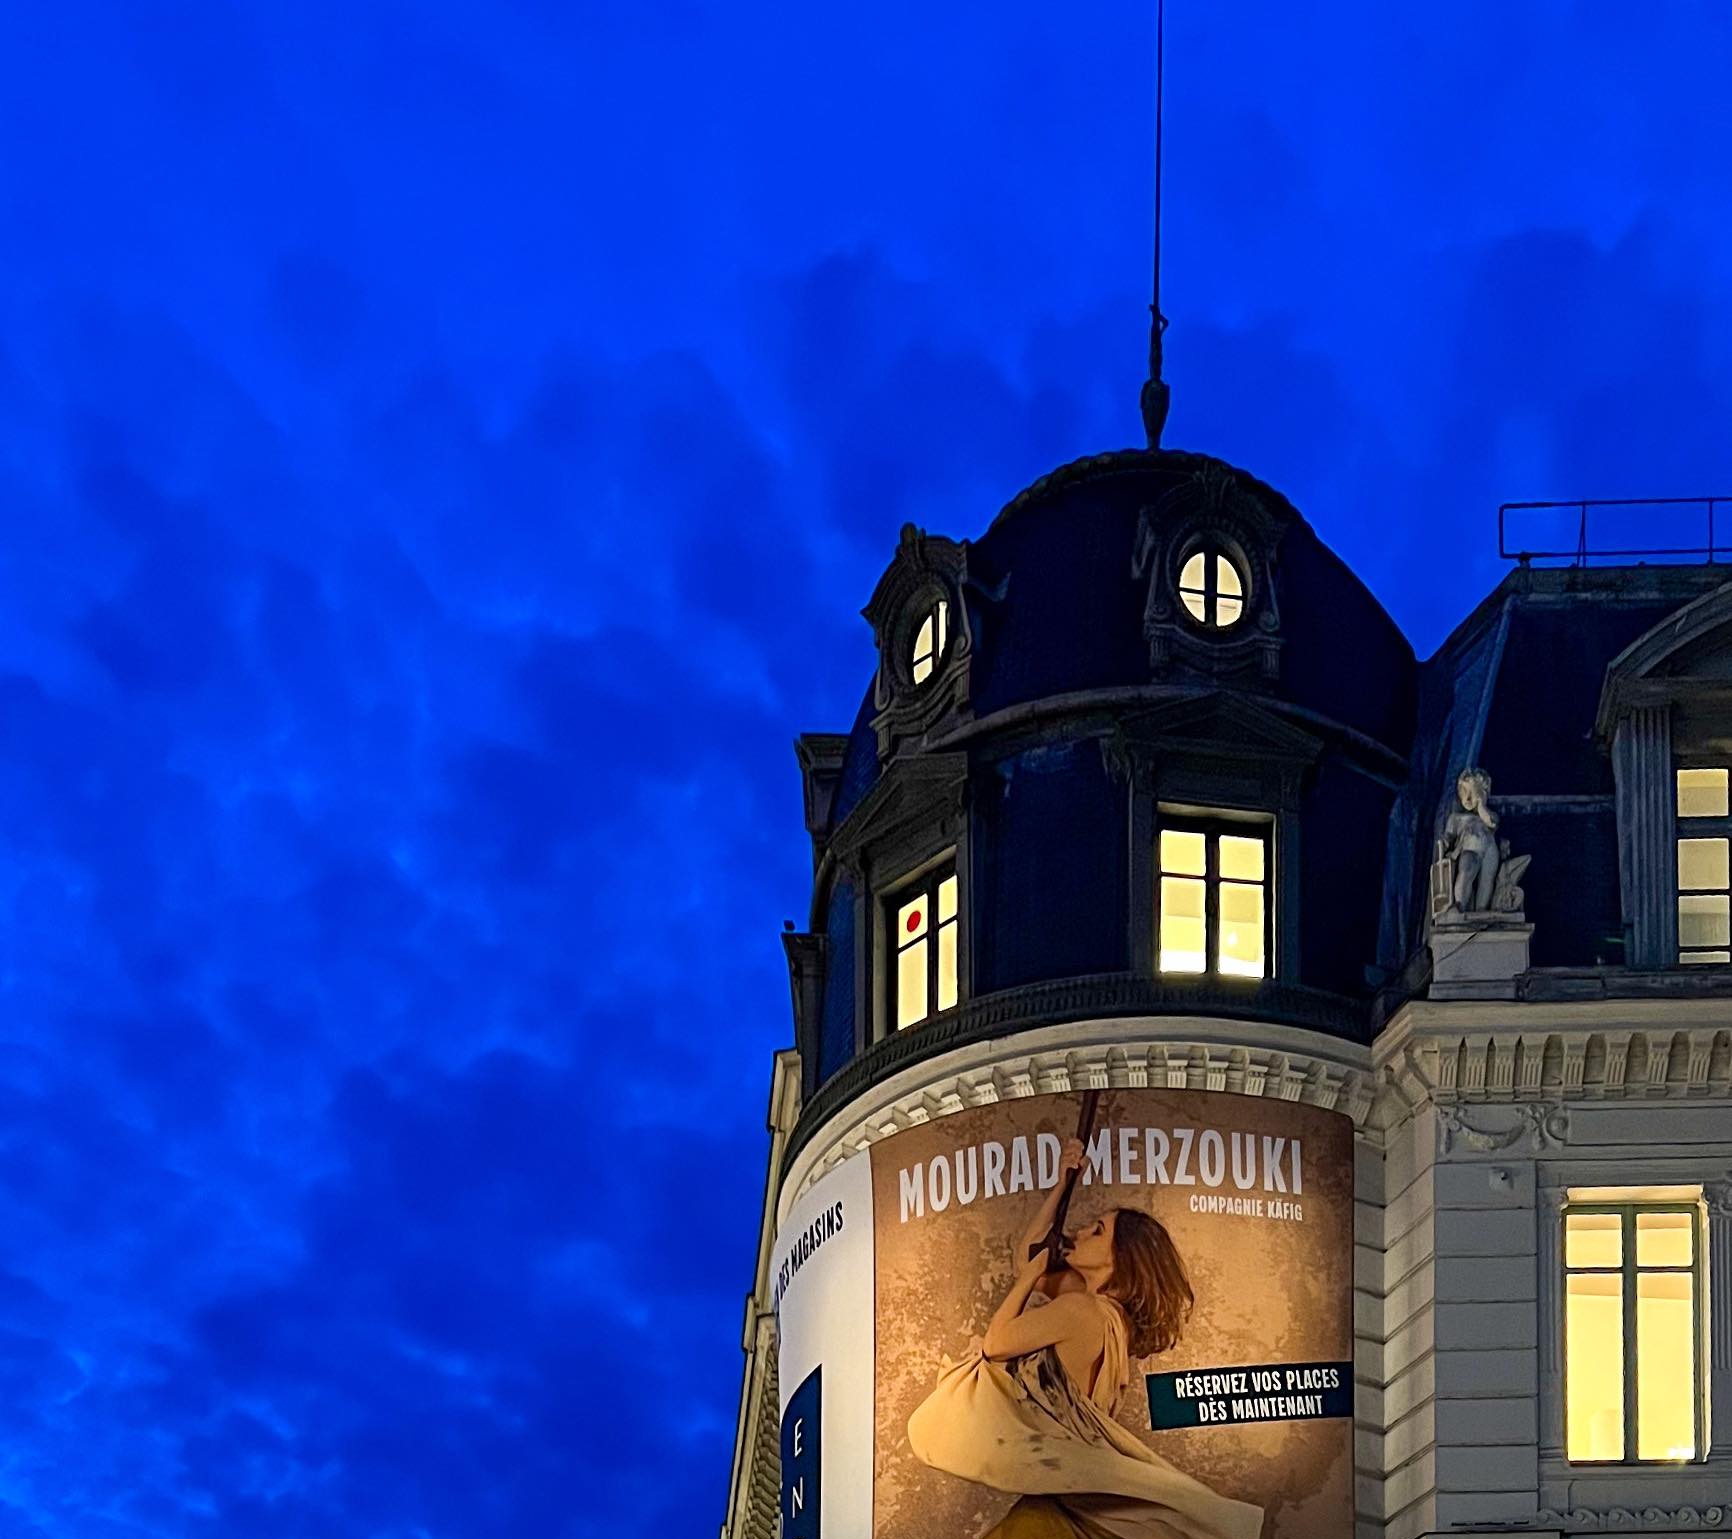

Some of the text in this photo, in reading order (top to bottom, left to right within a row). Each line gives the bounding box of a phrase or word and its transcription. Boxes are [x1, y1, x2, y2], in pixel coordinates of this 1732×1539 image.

[900, 1127, 1302, 1224] MOURAD MERZOUKI
[1190, 1195, 1303, 1221] COMPAGNIE KÄFIG
[791, 1201, 843, 1277] MAGASINS
[1175, 1368, 1340, 1398] RÉSERVEZ VOS PLACES
[1199, 1395, 1323, 1422] DÈS MAINTENANT
